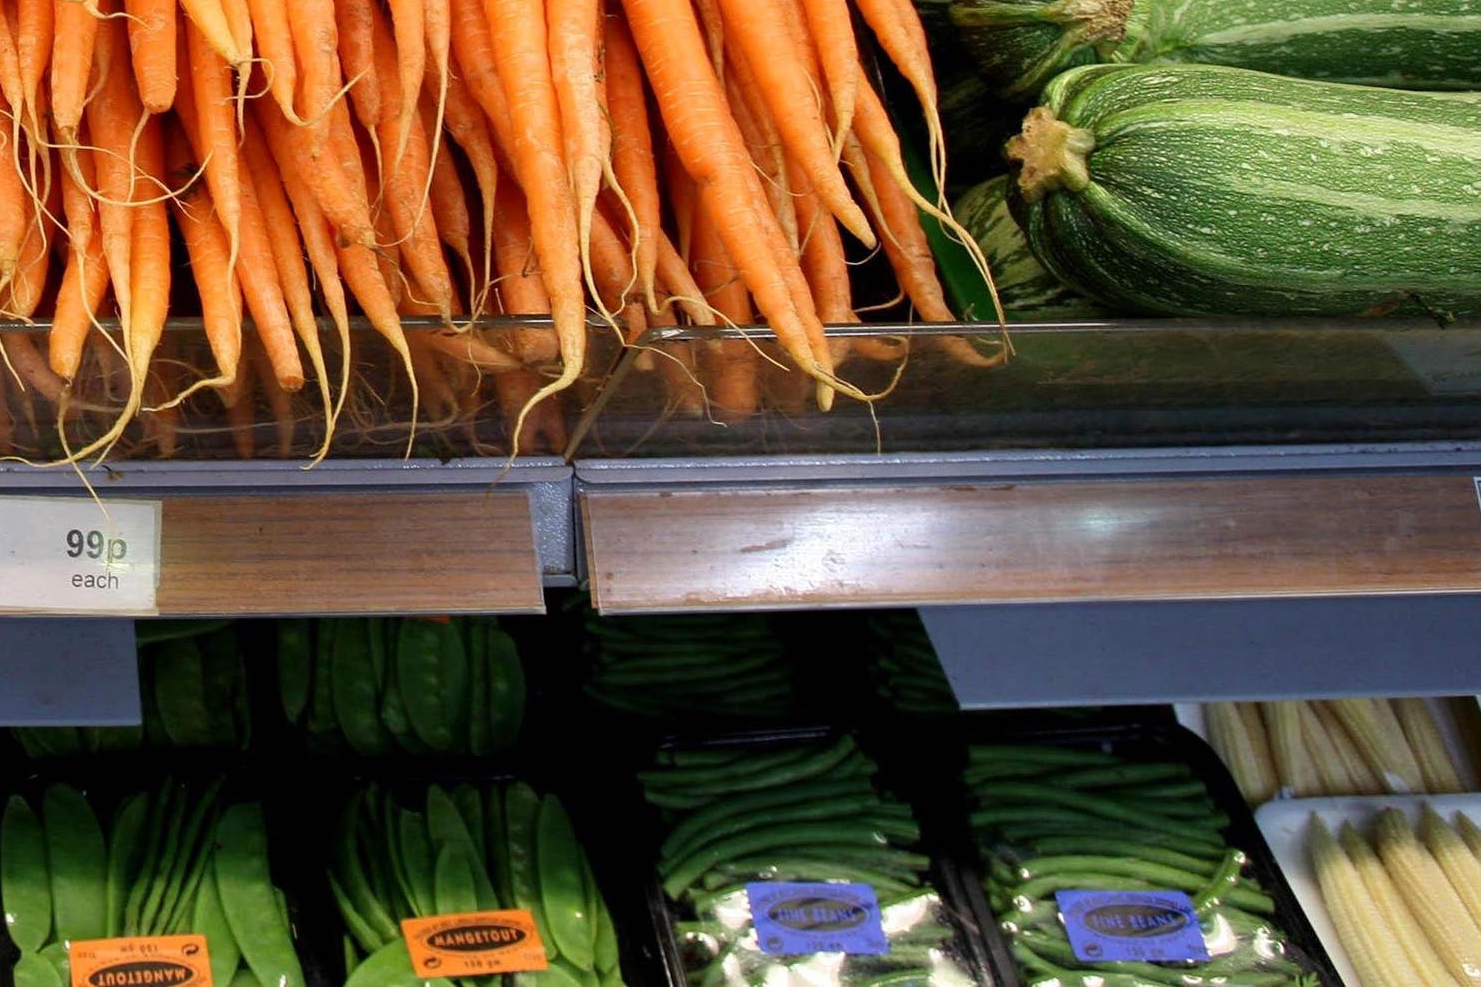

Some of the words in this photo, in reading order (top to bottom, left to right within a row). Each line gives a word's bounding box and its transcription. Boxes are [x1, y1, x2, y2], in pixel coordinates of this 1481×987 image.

[66, 529, 127, 567] 99p
[71, 571, 119, 589] each
[433, 929, 519, 948] MANGETOUT
[97, 967, 187, 987] MANGETOUT
